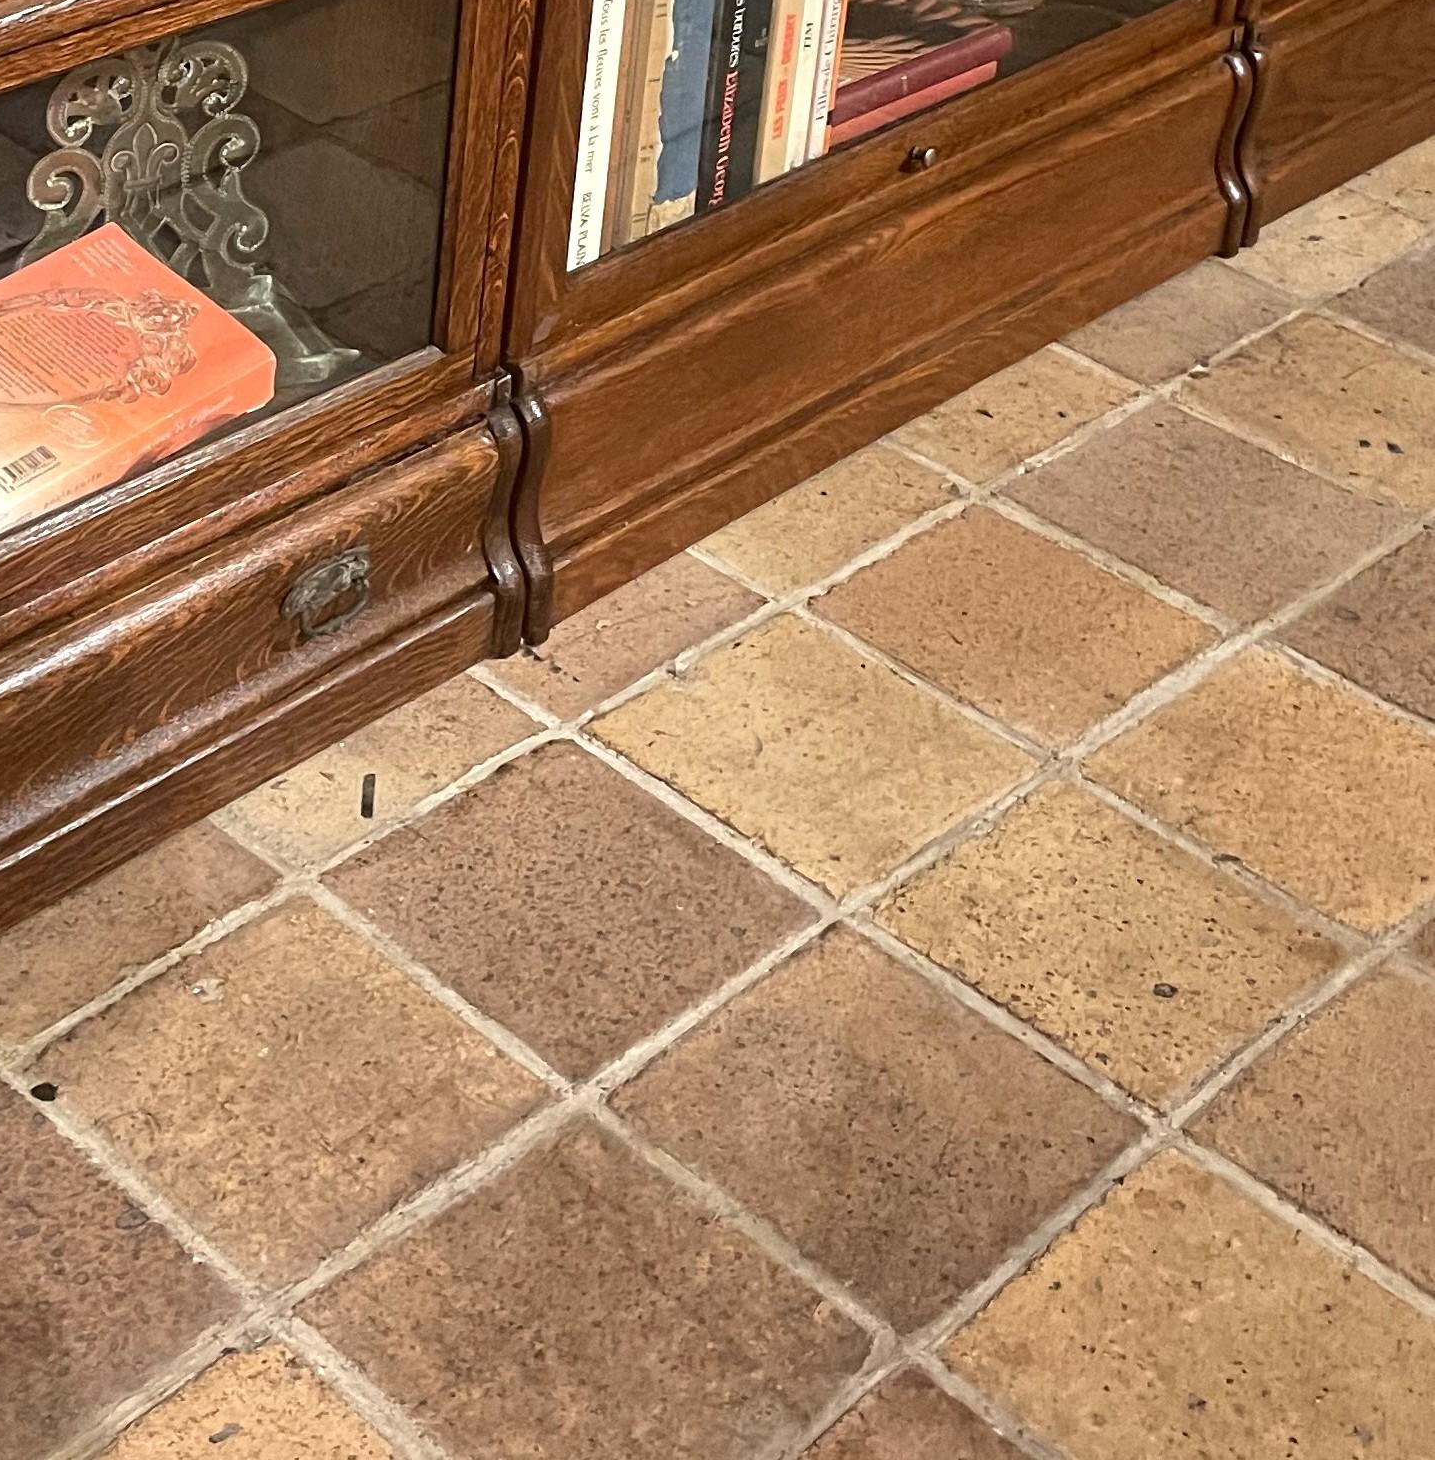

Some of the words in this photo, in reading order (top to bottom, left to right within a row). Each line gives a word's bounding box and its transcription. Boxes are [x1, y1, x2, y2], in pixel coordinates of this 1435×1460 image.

[598, 28, 609, 44] les
[803, 22, 814, 51] TIM
[594, 48, 609, 90] fleuves
[590, 93, 603, 122] vont
[717, 70, 741, 154] Elizabeth
[584, 150, 596, 174] mer
[578, 191, 594, 229] BELVA
